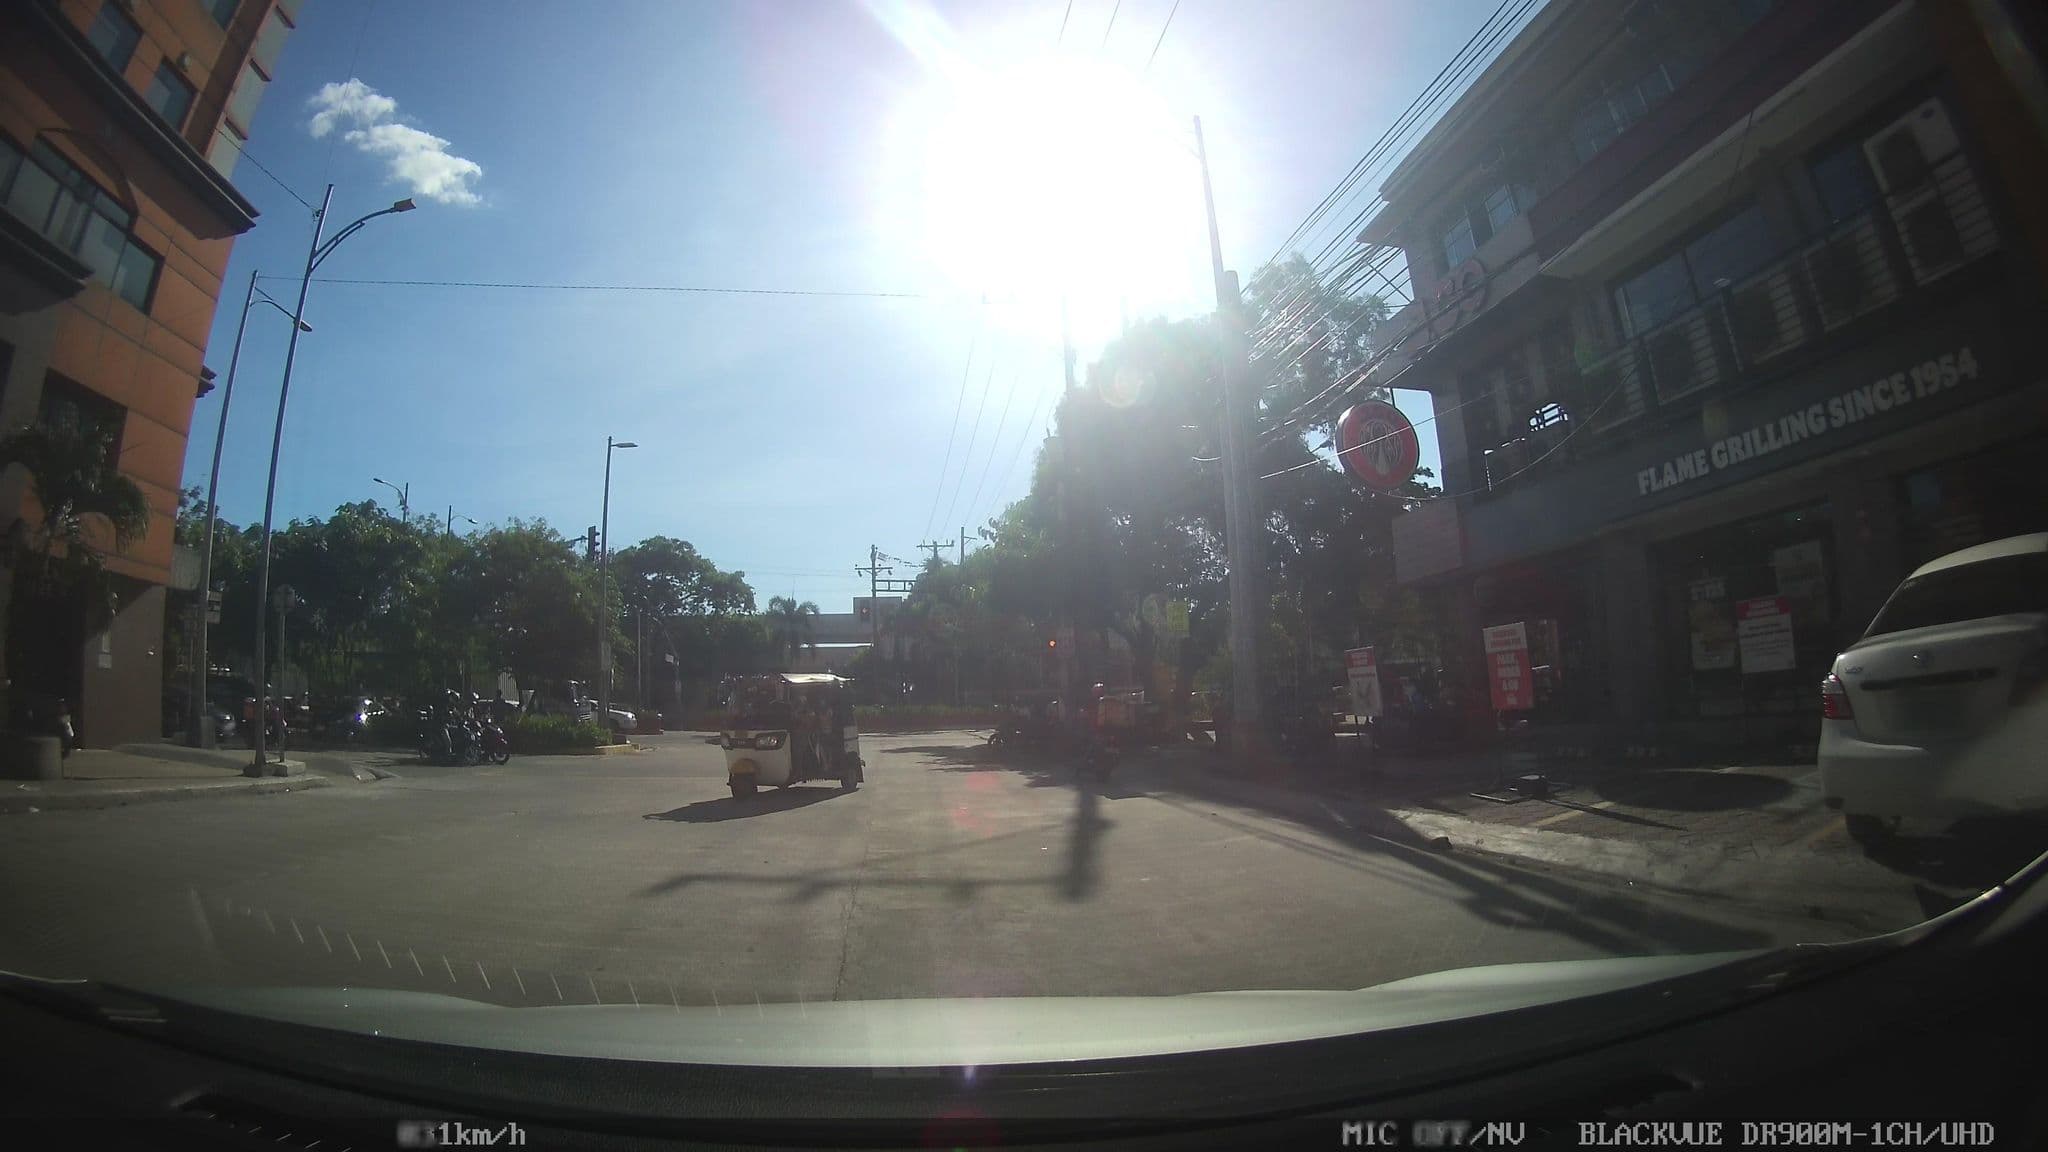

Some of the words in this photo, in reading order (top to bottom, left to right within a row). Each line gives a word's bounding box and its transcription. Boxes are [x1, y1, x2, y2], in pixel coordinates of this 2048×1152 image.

[1638, 449, 1709, 495] FLAME
[1711, 403, 1827, 469] GRILLING
[1828, 372, 1911, 428] SINCE
[1910, 347, 1979, 398] 1954
